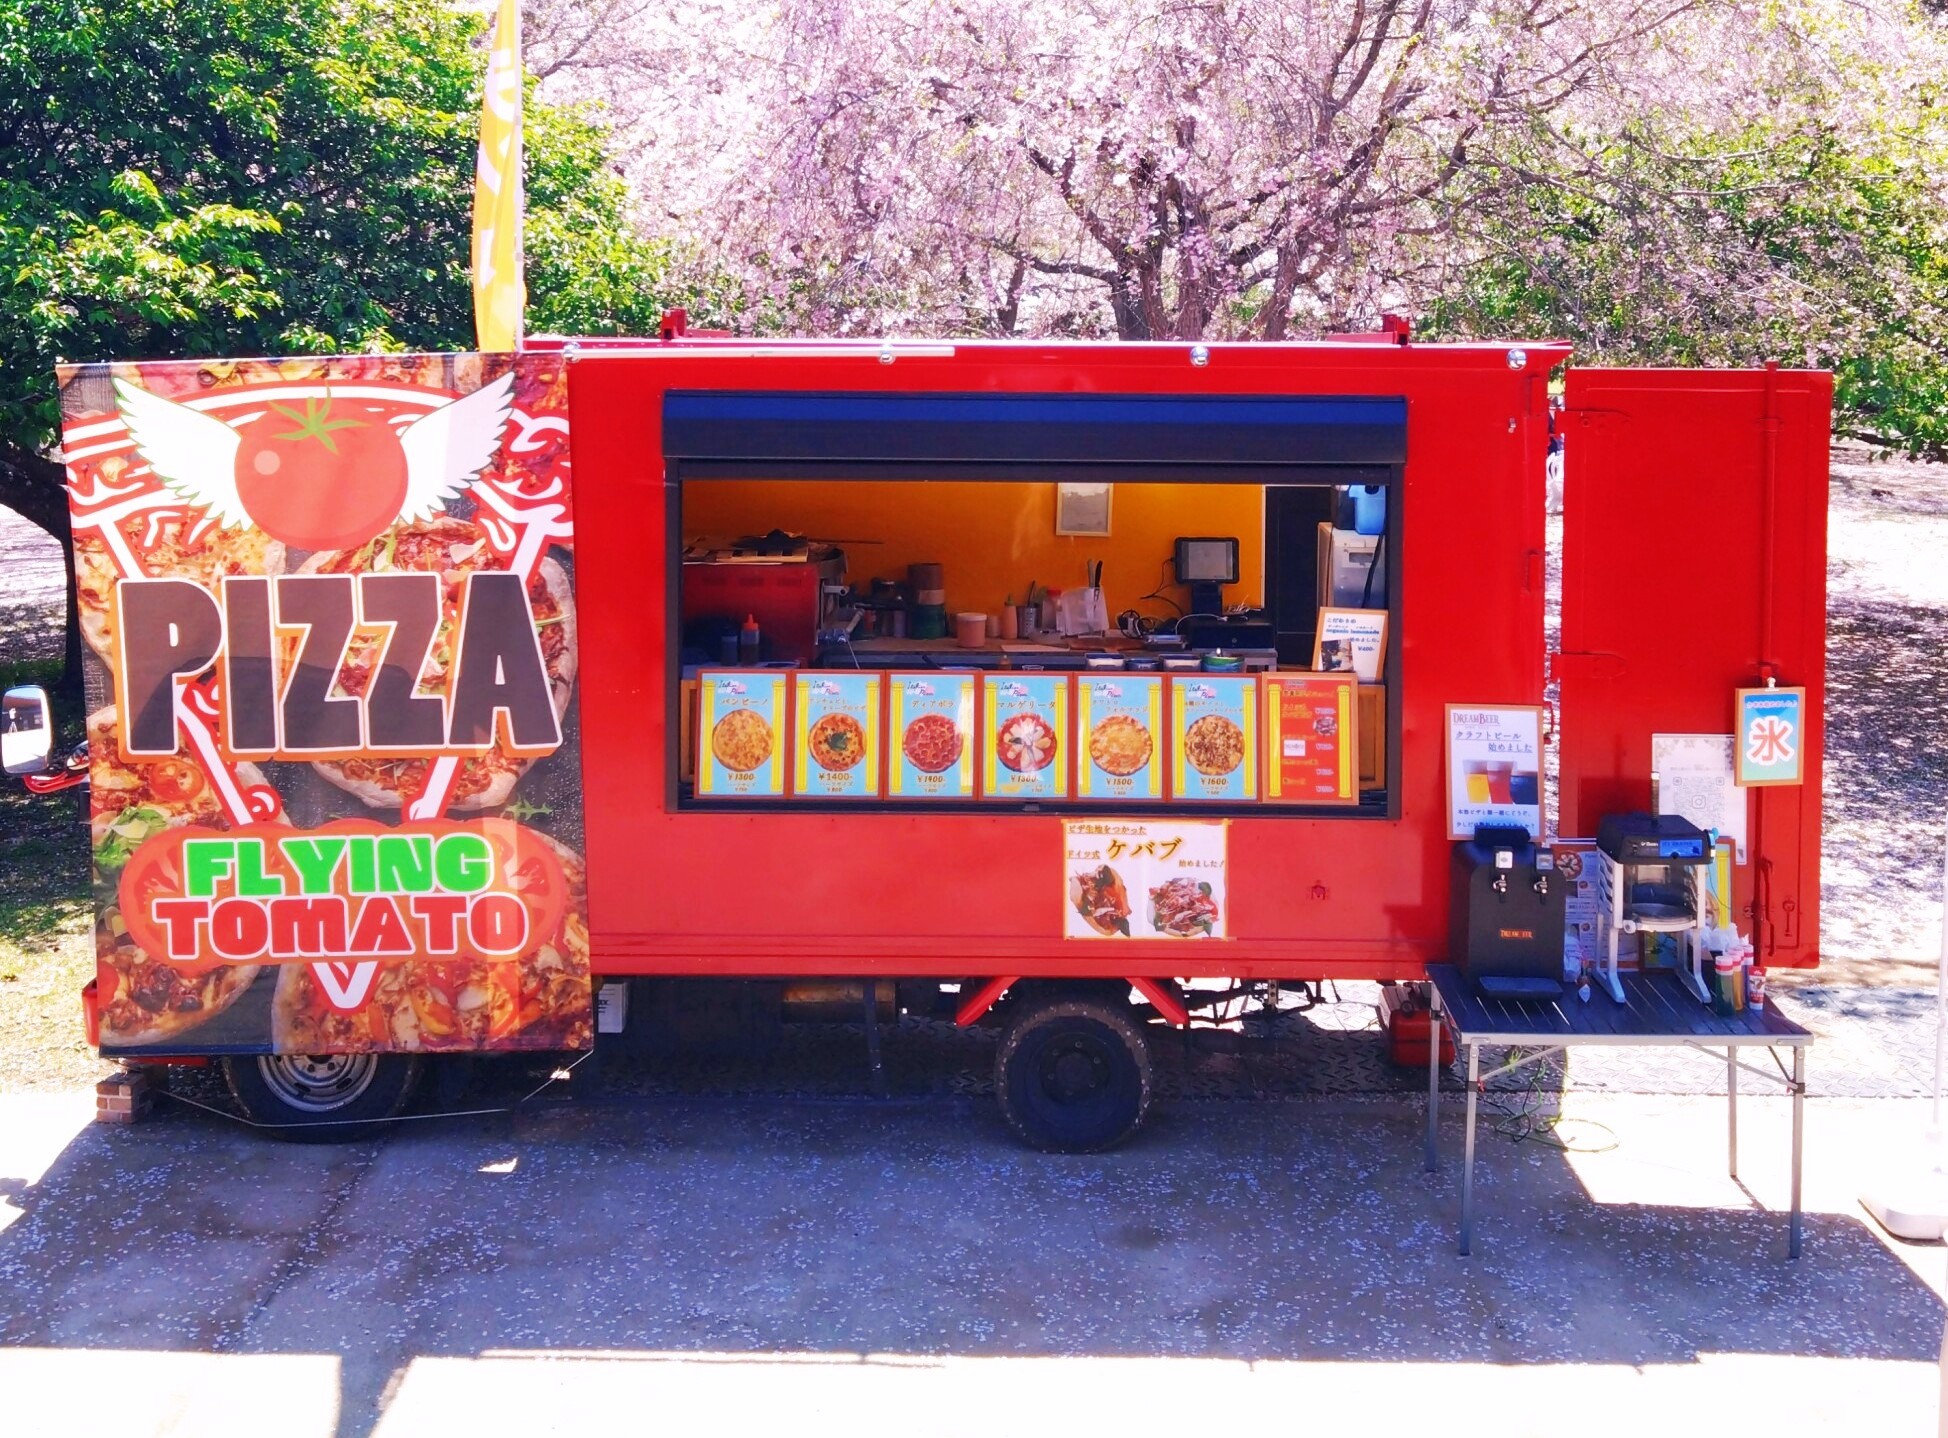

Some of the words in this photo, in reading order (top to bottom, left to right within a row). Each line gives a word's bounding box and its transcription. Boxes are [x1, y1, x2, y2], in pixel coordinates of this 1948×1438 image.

[115, 570, 564, 758] PIZZA
[998, 700, 1056, 708] マルゲリータ
[1455, 730, 1521, 740] クラフトビール
[1749, 718, 1792, 763] 氷
[1488, 742, 1533, 753] 始めました
[818, 773, 853, 781] ¥1400-
[1068, 824, 1147, 834] ピザ生地をつかった
[1107, 836, 1183, 861] ケバブ
[1067, 850, 1101, 860] ドイツ式
[182, 832, 495, 899] FLYING
[151, 892, 530, 959] TOMATO
